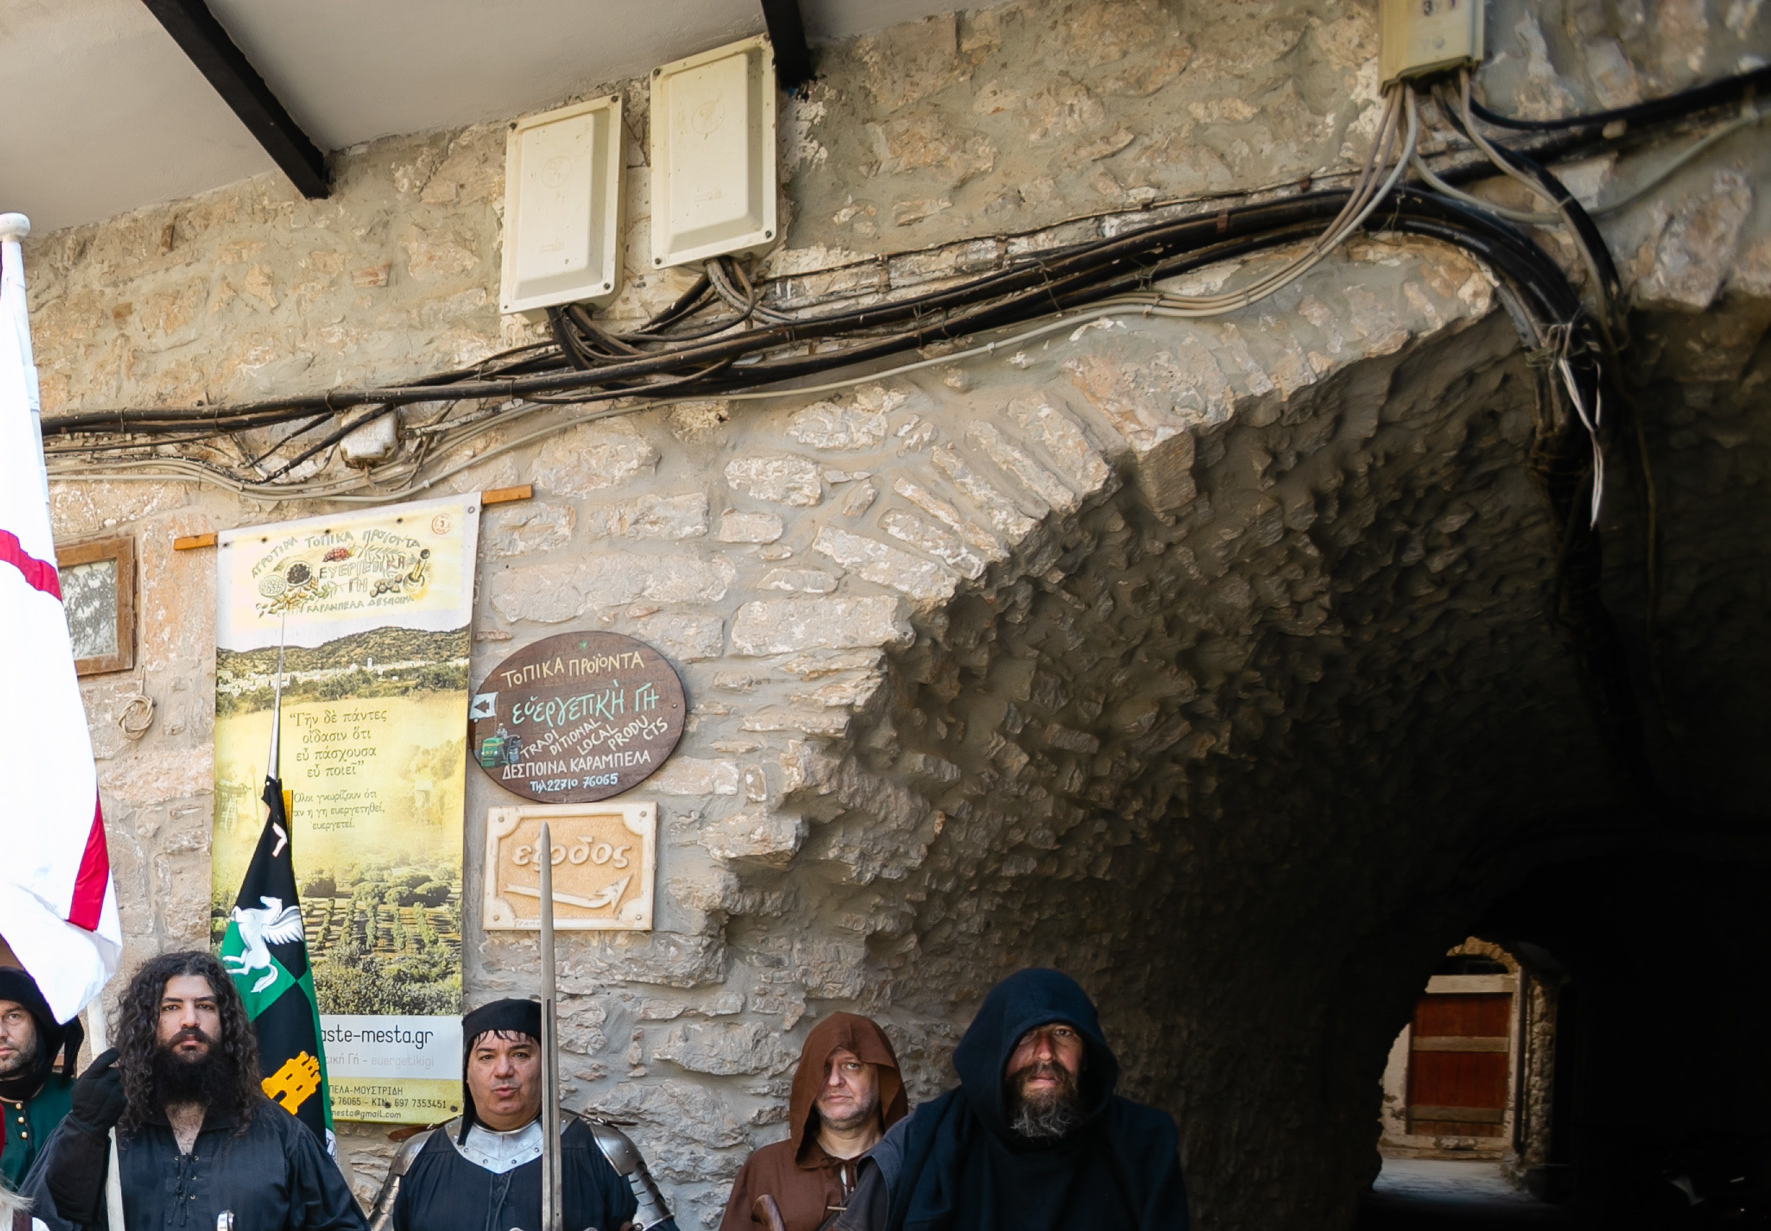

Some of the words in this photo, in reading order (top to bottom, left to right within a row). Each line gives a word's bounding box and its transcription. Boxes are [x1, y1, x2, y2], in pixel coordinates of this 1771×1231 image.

[343, 708, 387, 722] πάντες
[549, 718, 602, 755] DITIONAL
[608, 715, 650, 751] PRODU
[642, 717, 669, 740] CTS
[520, 729, 560, 759] TRADI
[577, 724, 619, 755] LOCAL
[315, 746, 376, 762] πάσχουσα
[502, 759, 567, 780] ΔΕΣΠΟΙΝΑ
[570, 750, 651, 772] ΚΑΡΑΜΠΕΛΑ
[582, 772, 618, 789] 76065
[292, 809, 304, 817] αν
[371, 1054, 434, 1070] euergetikigi
[338, 1097, 362, 1106] 76065
[394, 1099, 409, 1108] 697
[412, 1099, 447, 1109] 7353451
